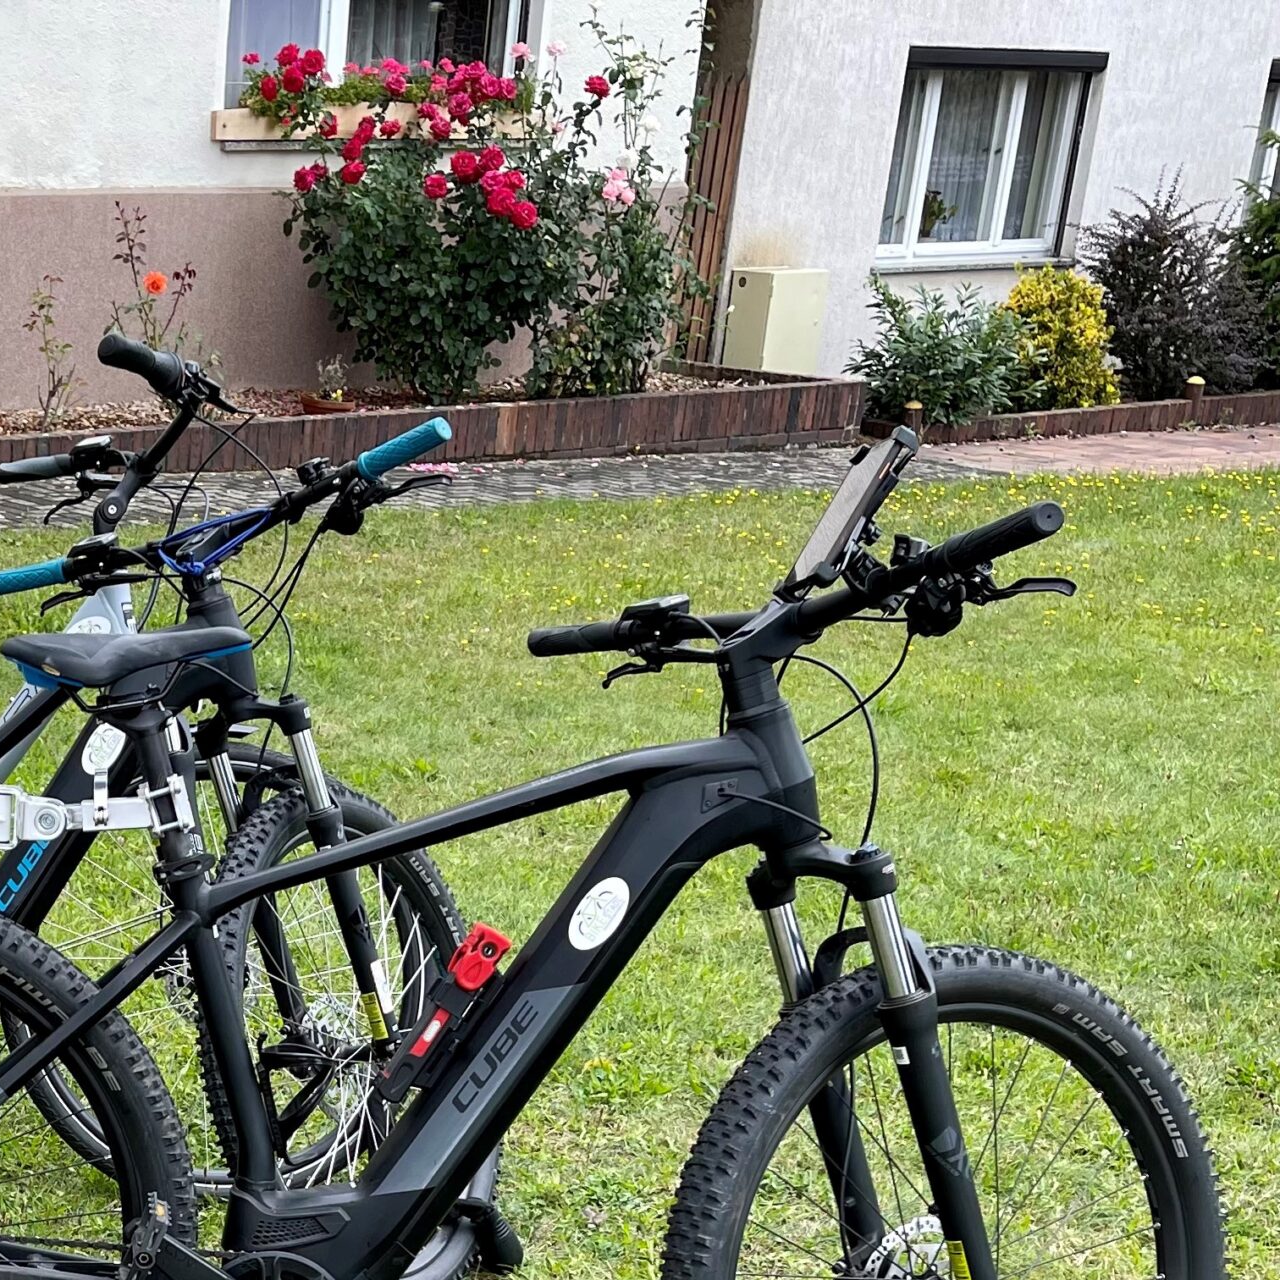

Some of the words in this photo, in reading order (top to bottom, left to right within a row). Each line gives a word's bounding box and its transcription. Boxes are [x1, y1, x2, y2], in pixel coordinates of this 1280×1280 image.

[451, 1000, 539, 1114] CUBE
[1071, 1012, 1129, 1057] SAM
[1126, 1064, 1189, 1158] SMART
